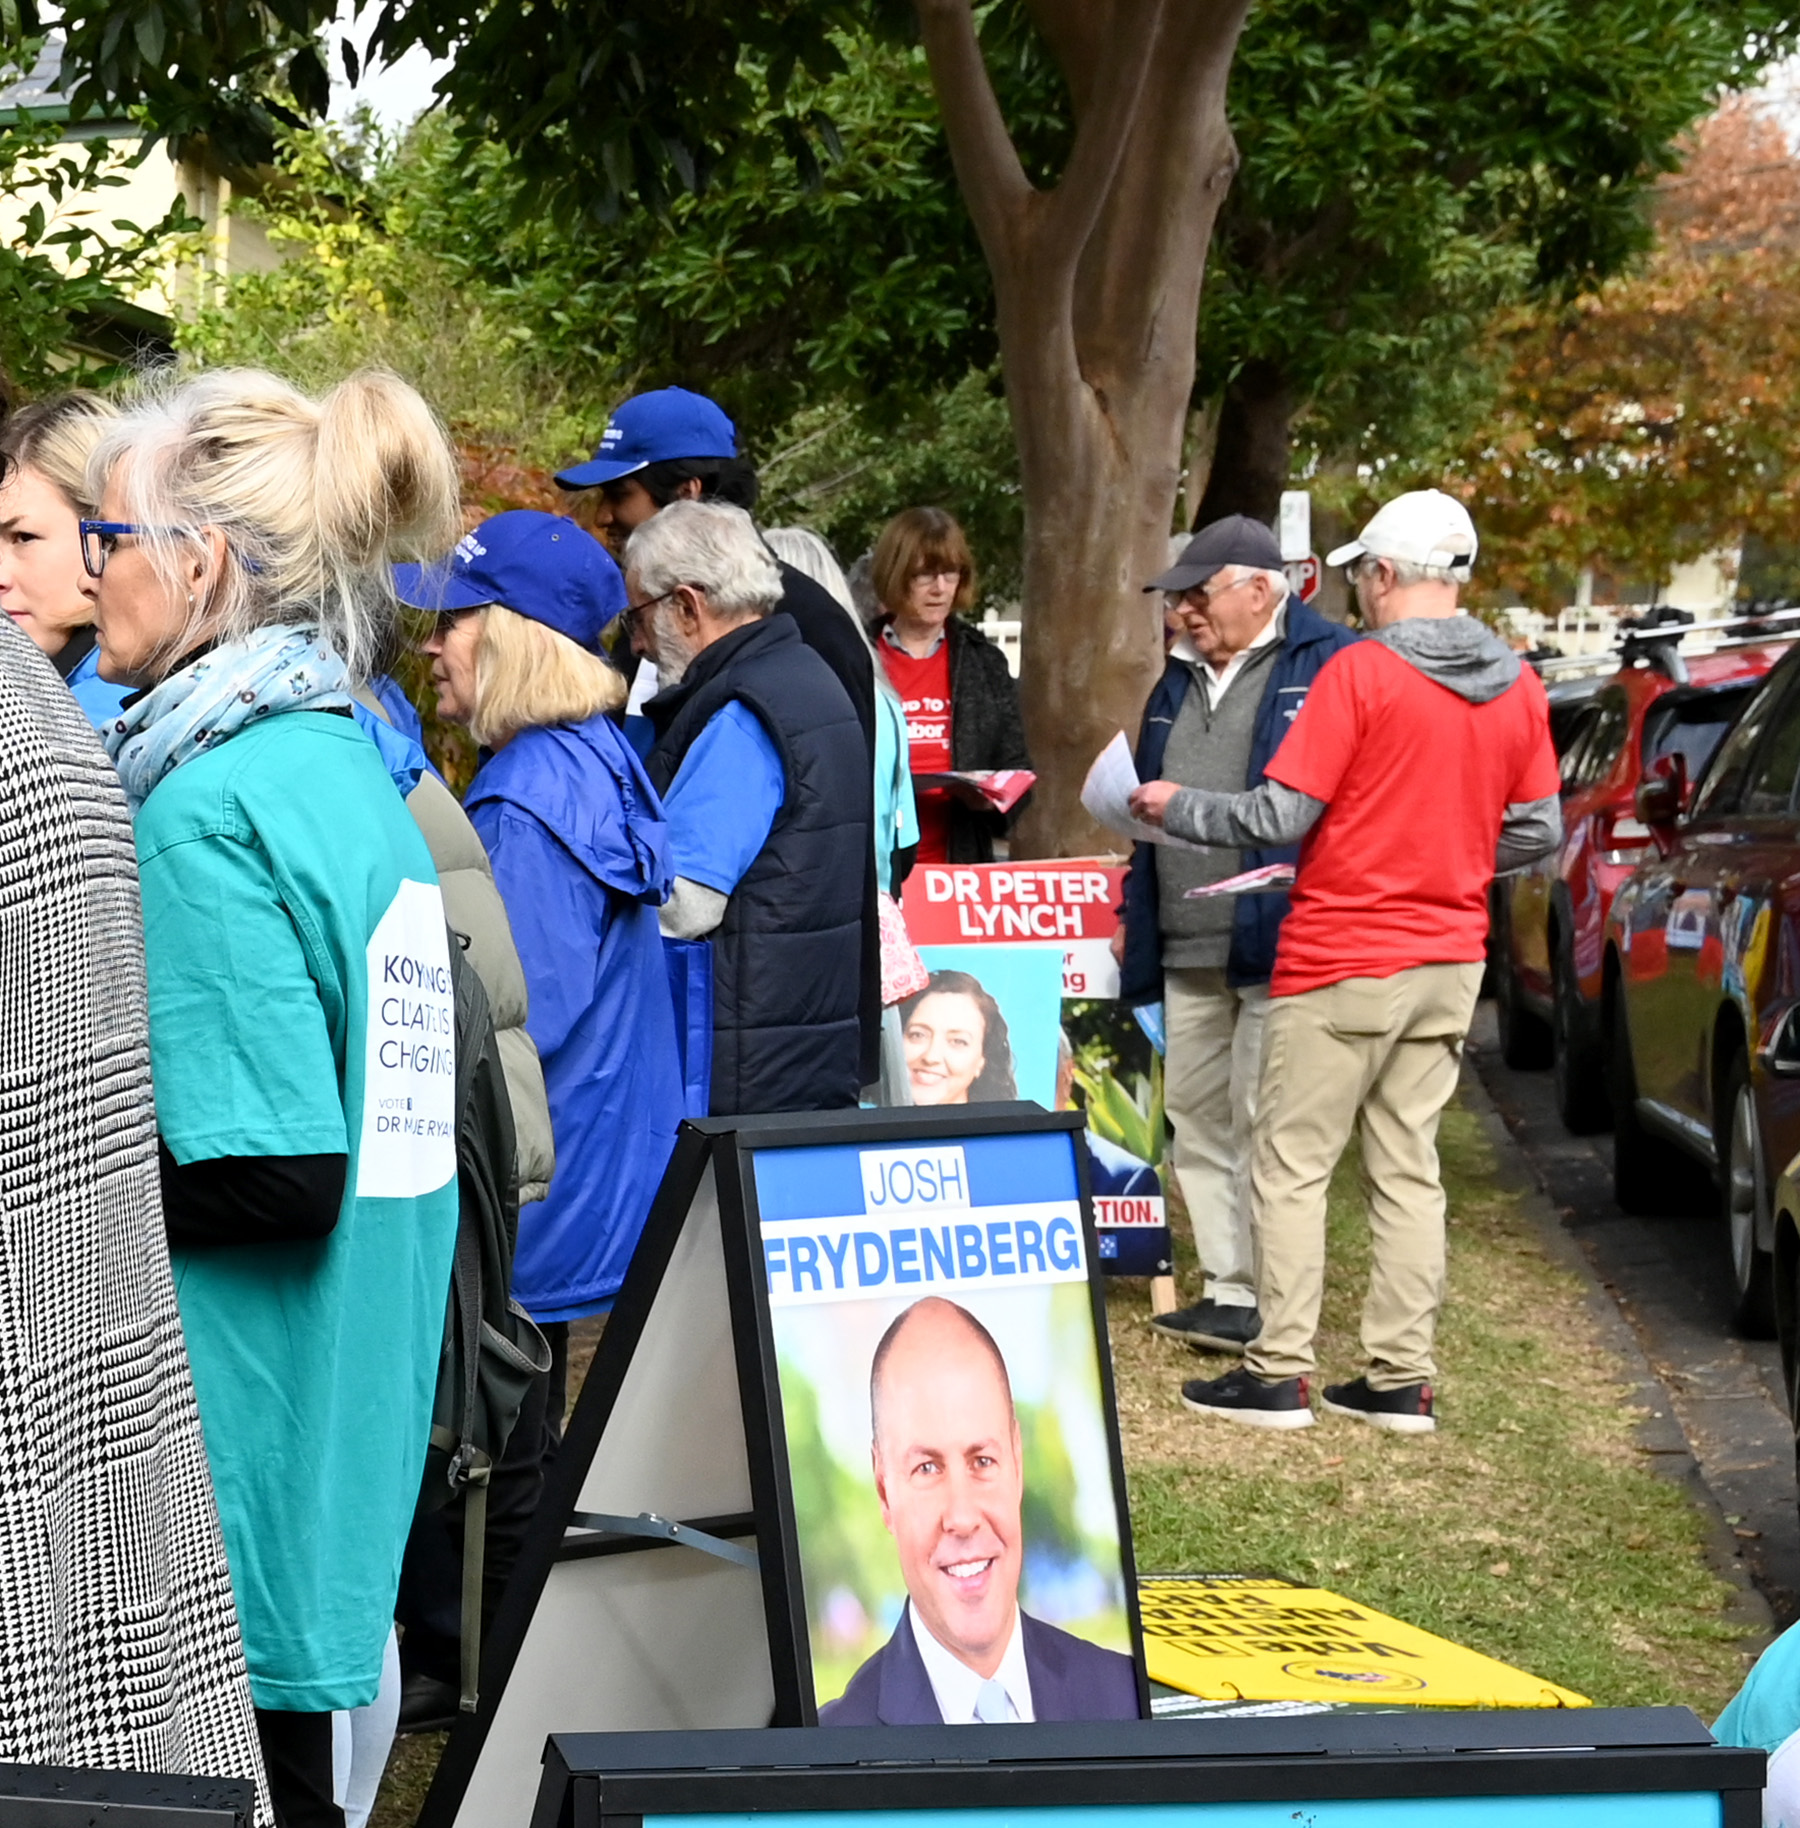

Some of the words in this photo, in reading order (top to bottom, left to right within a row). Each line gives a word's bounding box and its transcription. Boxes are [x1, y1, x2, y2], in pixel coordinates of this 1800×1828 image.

[925, 870, 980, 903] DR
[991, 869, 1111, 904] PETER
[959, 904, 1084, 937] LYNCH
[379, 1098, 406, 1110] VOTE
[377, 1116, 400, 1133] DR
[870, 1158, 963, 1206] JOSH
[1096, 1199, 1158, 1225] TION.
[763, 1217, 1081, 1294] FRYDENBERG
[1141, 1608, 1368, 1622] AUSTRA
[1242, 1640, 1423, 1659] Vote
